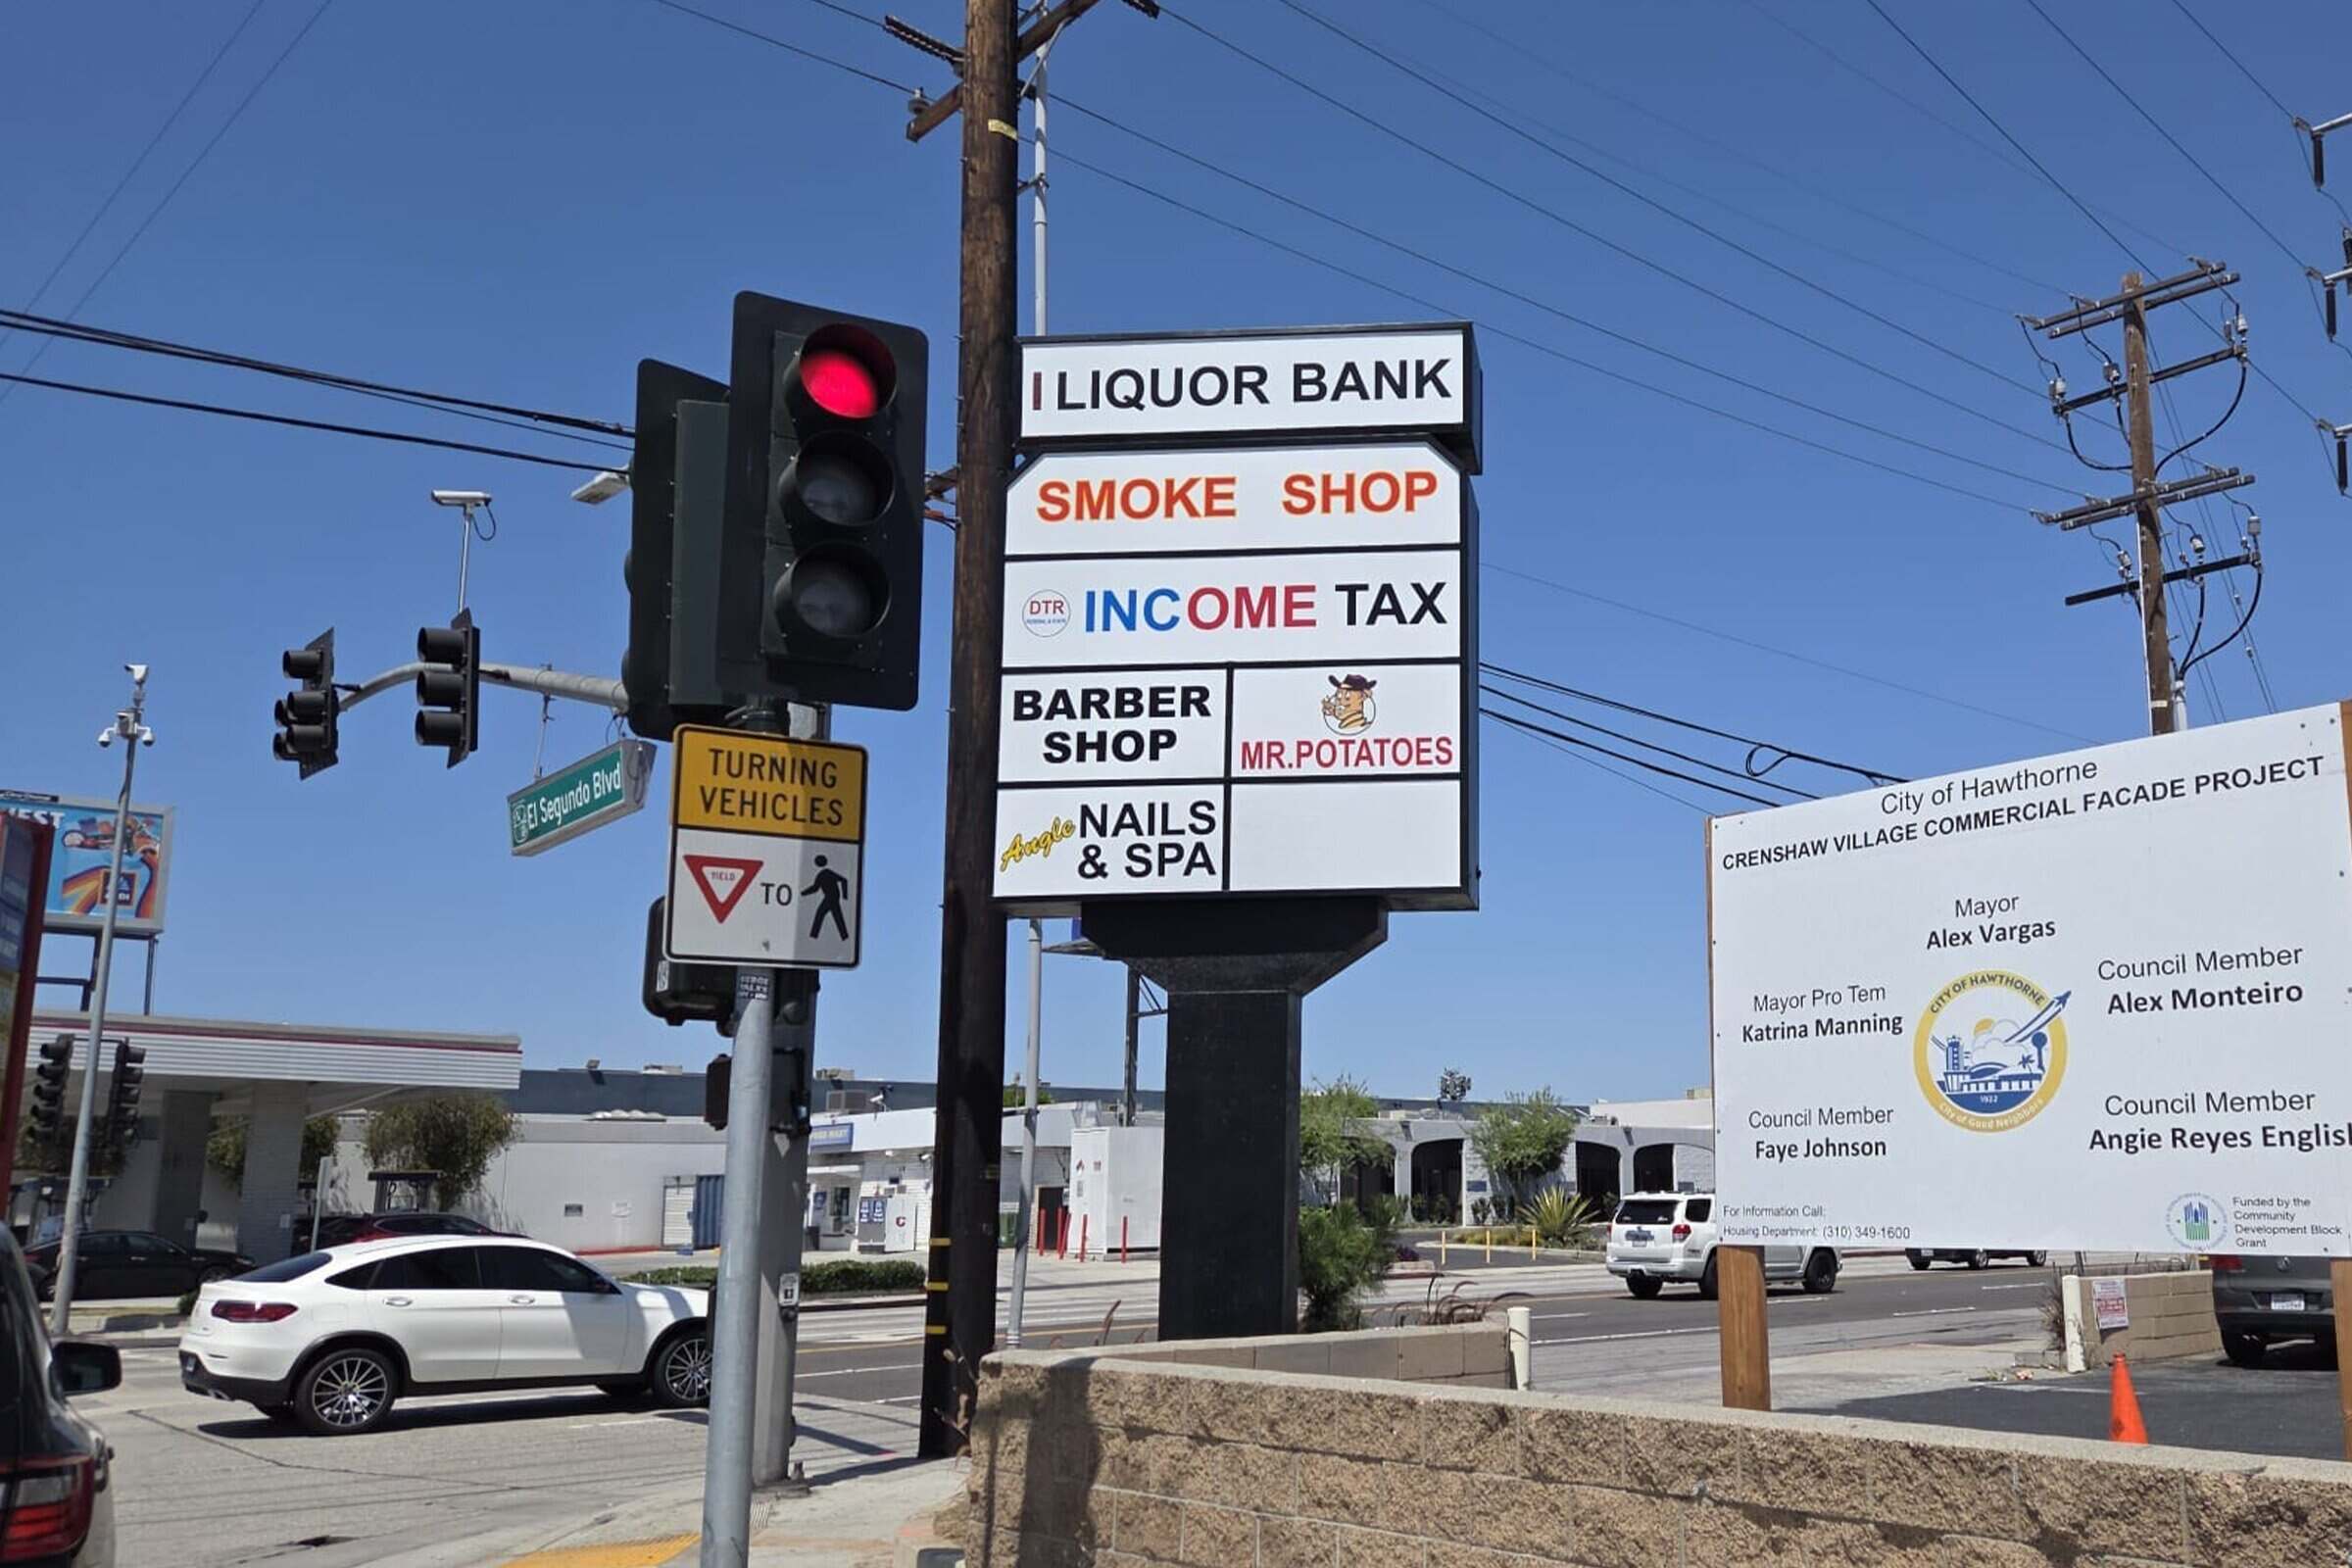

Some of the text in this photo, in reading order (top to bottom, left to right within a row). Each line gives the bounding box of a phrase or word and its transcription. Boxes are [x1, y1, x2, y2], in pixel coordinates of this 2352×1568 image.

[1057, 367, 1270, 412] LIQUOR
[1293, 359, 1451, 403] BANK
[1037, 471, 1437, 521] SMOKE SHOP
[1030, 600, 1064, 614] DTR
[1085, 582, 1447, 632] INCOME TAX
[1013, 686, 1211, 721] BARBER
[1043, 729, 1177, 763] SHOP
[709, 748, 838, 788] TURNING
[527, 761, 621, 830] El Segundo Blvd
[1882, 760, 2098, 815] City of Hawthorne
[700, 786, 843, 826] VEHICLES
[1080, 800, 1216, 838] NAILS
[1723, 756, 2324, 870] CRENSHAW VILLAGE COMMERCIAL FACADE PROJECT
[1001, 816, 1076, 872] Angle
[1078, 842, 1216, 879] & SPA
[711, 872, 735, 881] YIELD
[760, 882, 793, 906] TO
[1955, 897, 2019, 919] Mayor
[1927, 921, 2055, 950] Alex Vargas
[2098, 947, 2303, 980] Council Member
[1754, 985, 1886, 1015] Mayor Pro Tem
[1931, 973, 2045, 1013] CITY OF HAWTHORNE
[2108, 982, 2303, 1014] Alex Monteiro
[1742, 1013, 1903, 1043] Katrina Manning
[1748, 1105, 1894, 1129] Council Member
[2105, 1090, 2316, 1115] Council Member
[1756, 1137, 1886, 1163] Faye Johnson
[2089, 1128, 2162, 1154] Angie
[2172, 1128, 2252, 1153] Reyes
[1723, 1204, 1740, 1217] For
[1742, 1205, 1799, 1217] Information
[2232, 1197, 2311, 1209] Funded by the
[2233, 1210, 2296, 1223] Community
[1723, 1225, 1759, 1239] Housing
[1823, 1225, 1852, 1241] (310)
[1855, 1226, 1910, 1240] 349-1600
[2234, 1224, 2342, 1236] Development Block
[2235, 1237, 2267, 1248] Grant
